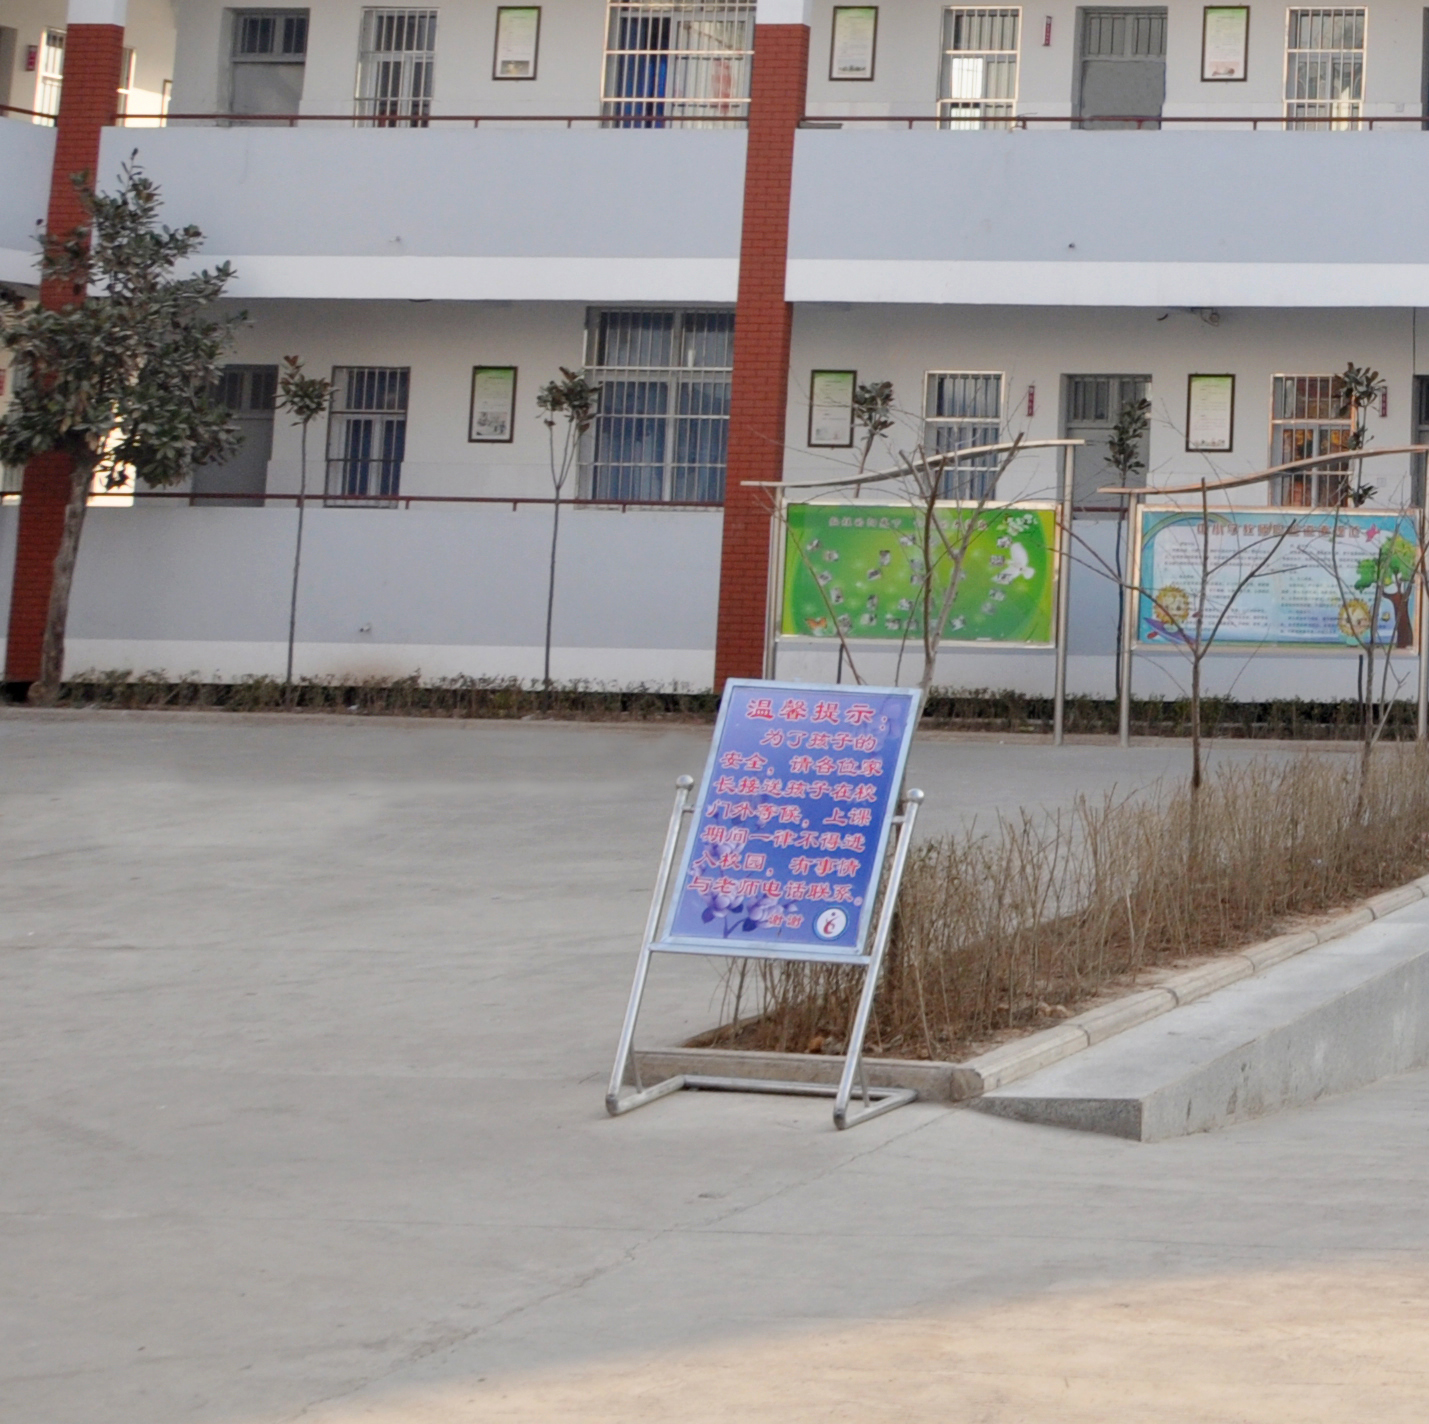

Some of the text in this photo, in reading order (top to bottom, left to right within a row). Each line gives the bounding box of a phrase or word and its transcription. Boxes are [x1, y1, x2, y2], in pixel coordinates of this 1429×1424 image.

[760, 729, 878, 753] 为了孩子的
[719, 751, 884, 778] 安全，请各位家
[713, 776, 878, 803] 长接送孩子在校
[700, 825, 866, 853] 期间一律不得进
[692, 852, 862, 878] 入校园，有事情
